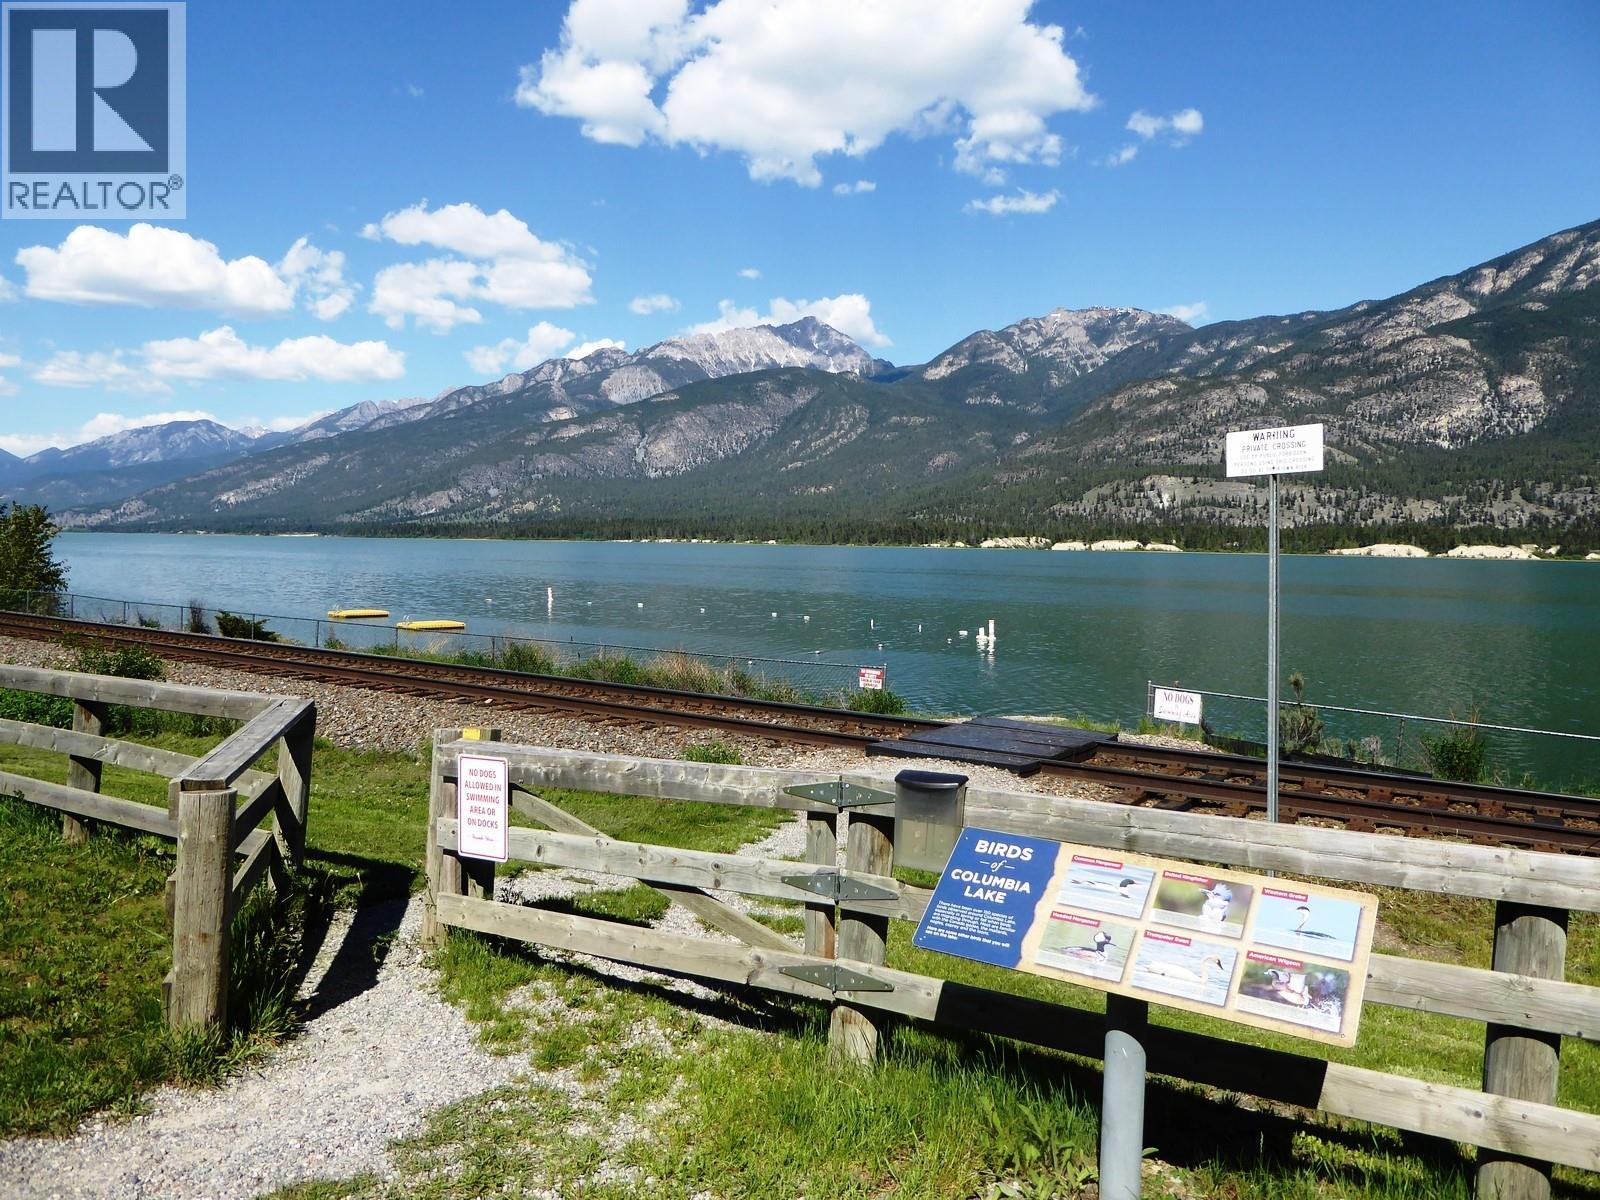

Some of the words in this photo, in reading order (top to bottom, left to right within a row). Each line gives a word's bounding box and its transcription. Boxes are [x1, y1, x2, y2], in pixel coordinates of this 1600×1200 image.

[1252, 429, 1296, 442] WARNING
[1241, 443, 1269, 452] PRIVATE
[1272, 440, 1306, 450] CROSSING
[1164, 691, 1173, 702] NO
[1175, 693, 1194, 704] DOGS
[469, 769, 478, 777] NO
[479, 770, 497, 779] DOGS
[464, 780, 495, 791] ALLOWED
[495, 784, 502, 792] IN
[466, 793, 500, 804] SWIMMING
[469, 805, 486, 815] AREA
[487, 807, 496, 816] OR
[467, 817, 477, 826] ON
[477, 819, 498, 829] DOCKS
[974, 839, 1034, 861] BIRDS
[990, 860, 1007, 873] of
[950, 868, 1031, 894] COLUMBIA
[963, 885, 1007, 904] LAKE
[1249, 952, 1276, 962] American
